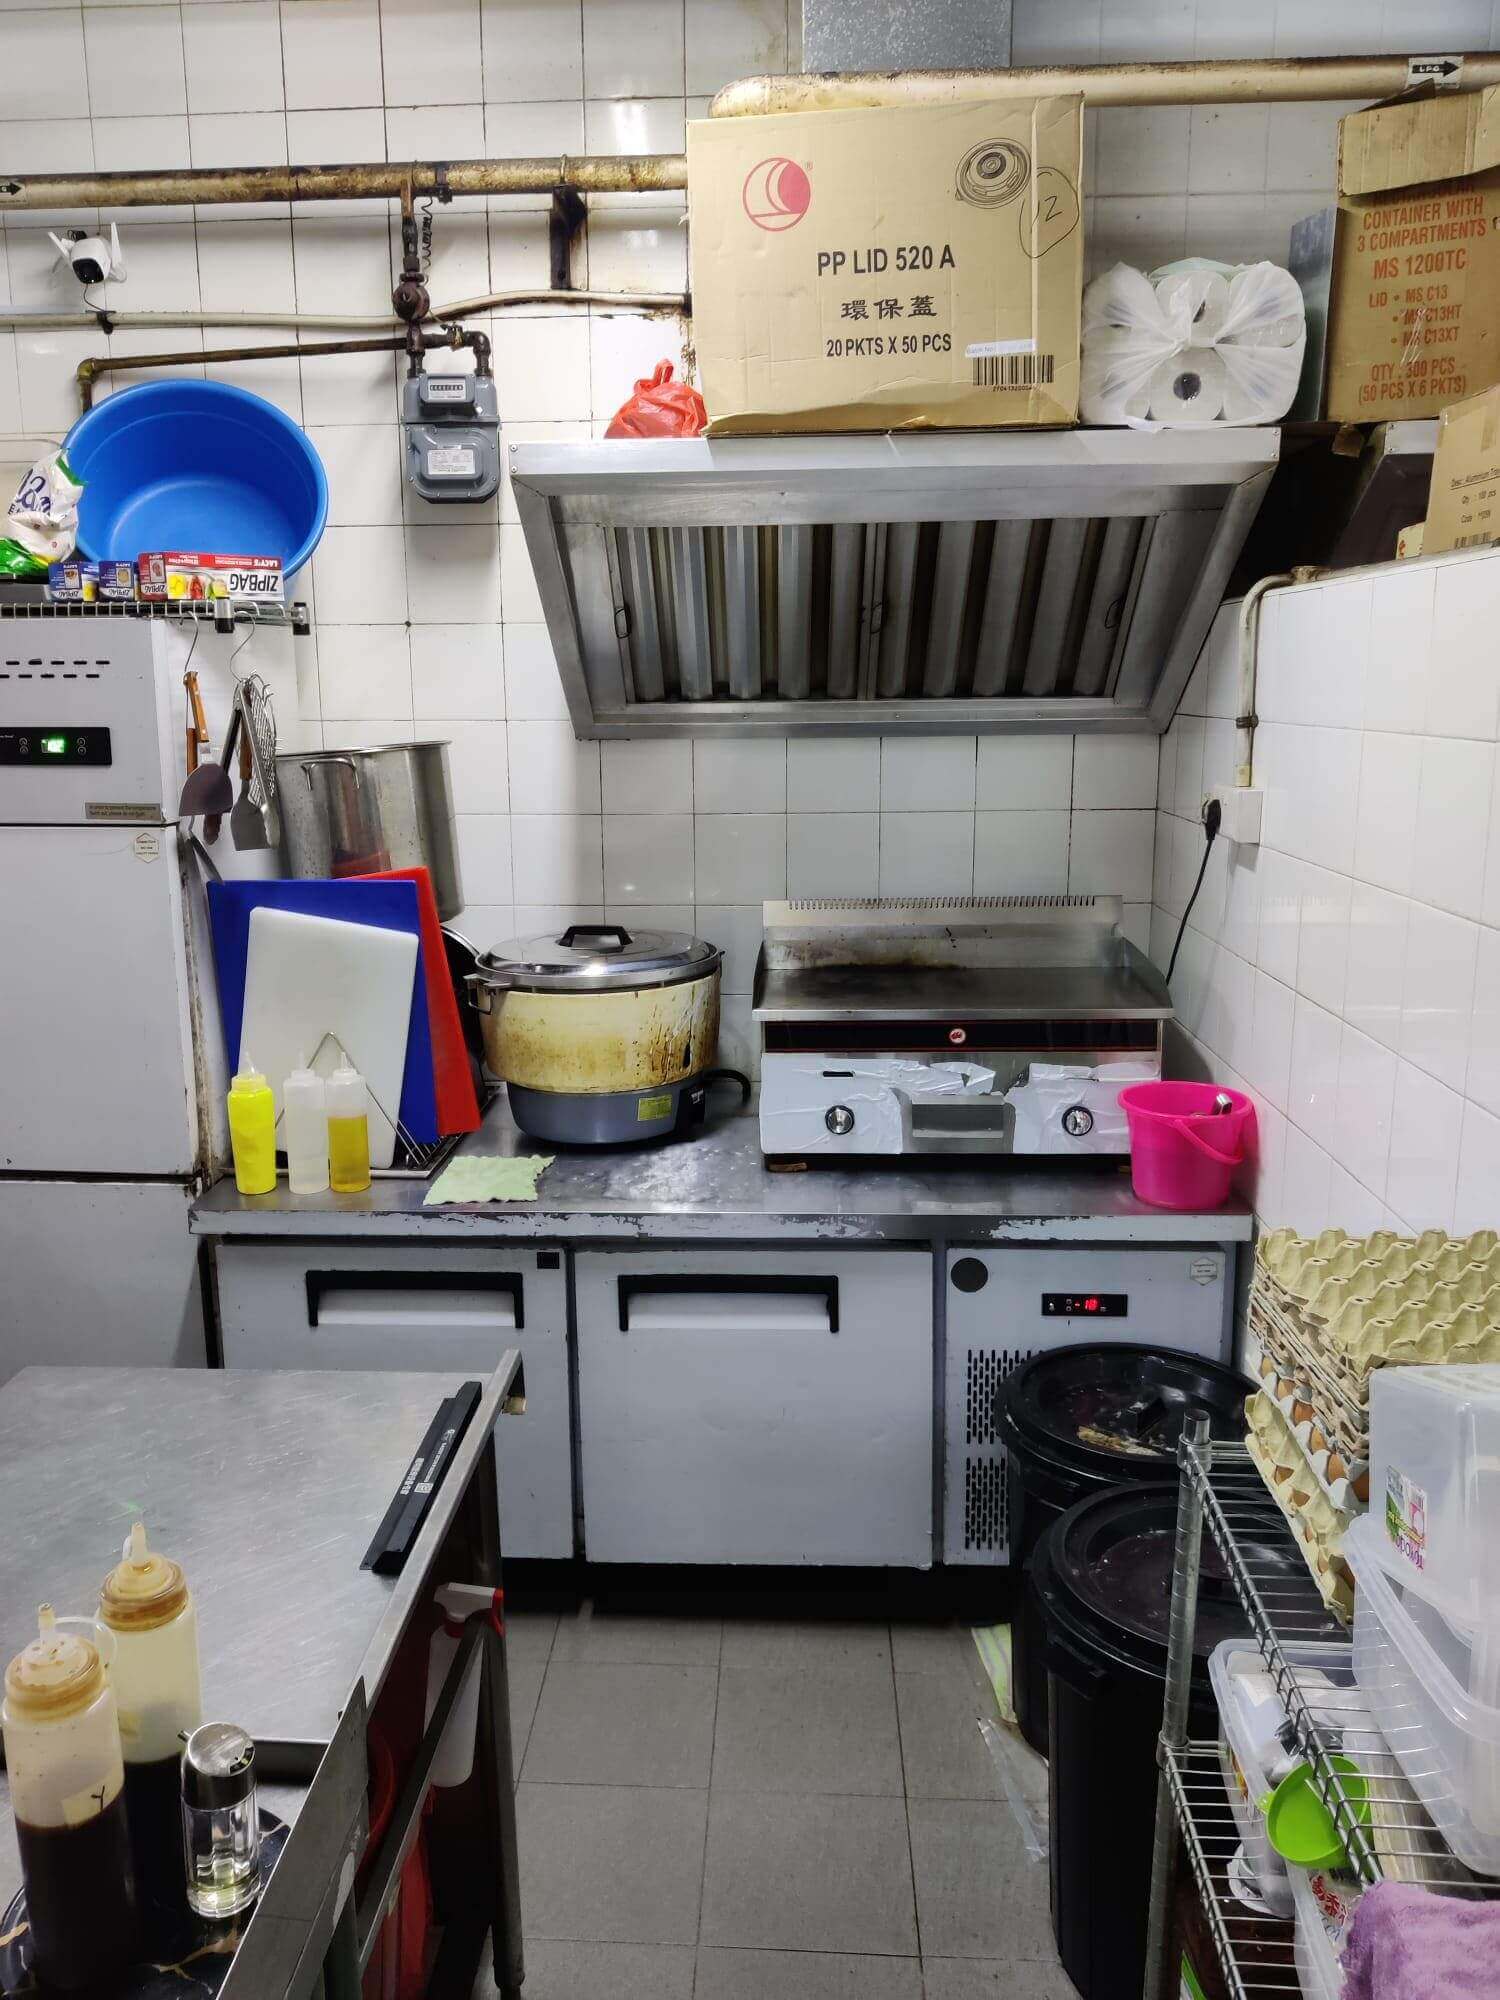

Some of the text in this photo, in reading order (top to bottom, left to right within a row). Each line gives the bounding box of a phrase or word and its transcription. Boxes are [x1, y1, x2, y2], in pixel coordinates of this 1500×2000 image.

[1419, 65, 1440, 73] LPG
[1363, 202, 1441, 231] CONTAINER
[1446, 195, 1484, 219] WITH
[1357, 217, 1487, 253] 3 COMPARTMENTS
[817, 244, 956, 276] PP LID 520 A
[1374, 248, 1467, 280] MS 1200TC
[840, 294, 938, 321] 環保蓋
[1368, 284, 1449, 308] LID MS C13
[1425, 304, 1462, 322] C13HT
[827, 333, 952, 357] 20 PKTS X 50 PCS
[1424, 326, 1460, 345] C13XT
[1371, 356, 1456, 382] QTY 300 PCS
[1358, 374, 1467, 406] (50 PCS X 6 PKTS)
[230, 573, 279, 592] ZIPBAG
